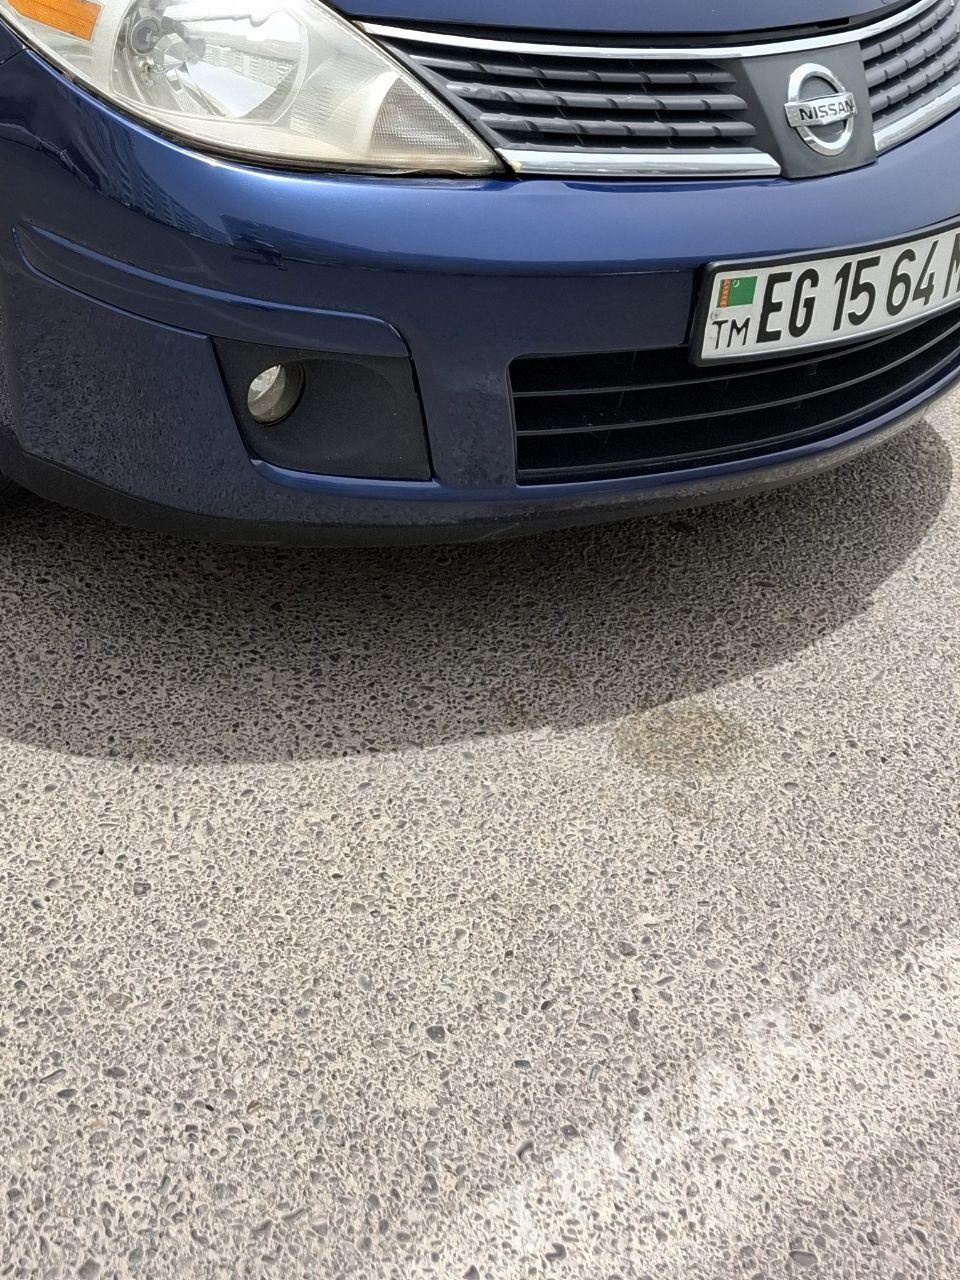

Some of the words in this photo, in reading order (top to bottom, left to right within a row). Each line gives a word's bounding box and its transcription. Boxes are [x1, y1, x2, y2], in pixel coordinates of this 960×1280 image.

[799, 100, 854, 120] NISSAN
[756, 268, 819, 344] EG
[712, 317, 751, 350] TM
